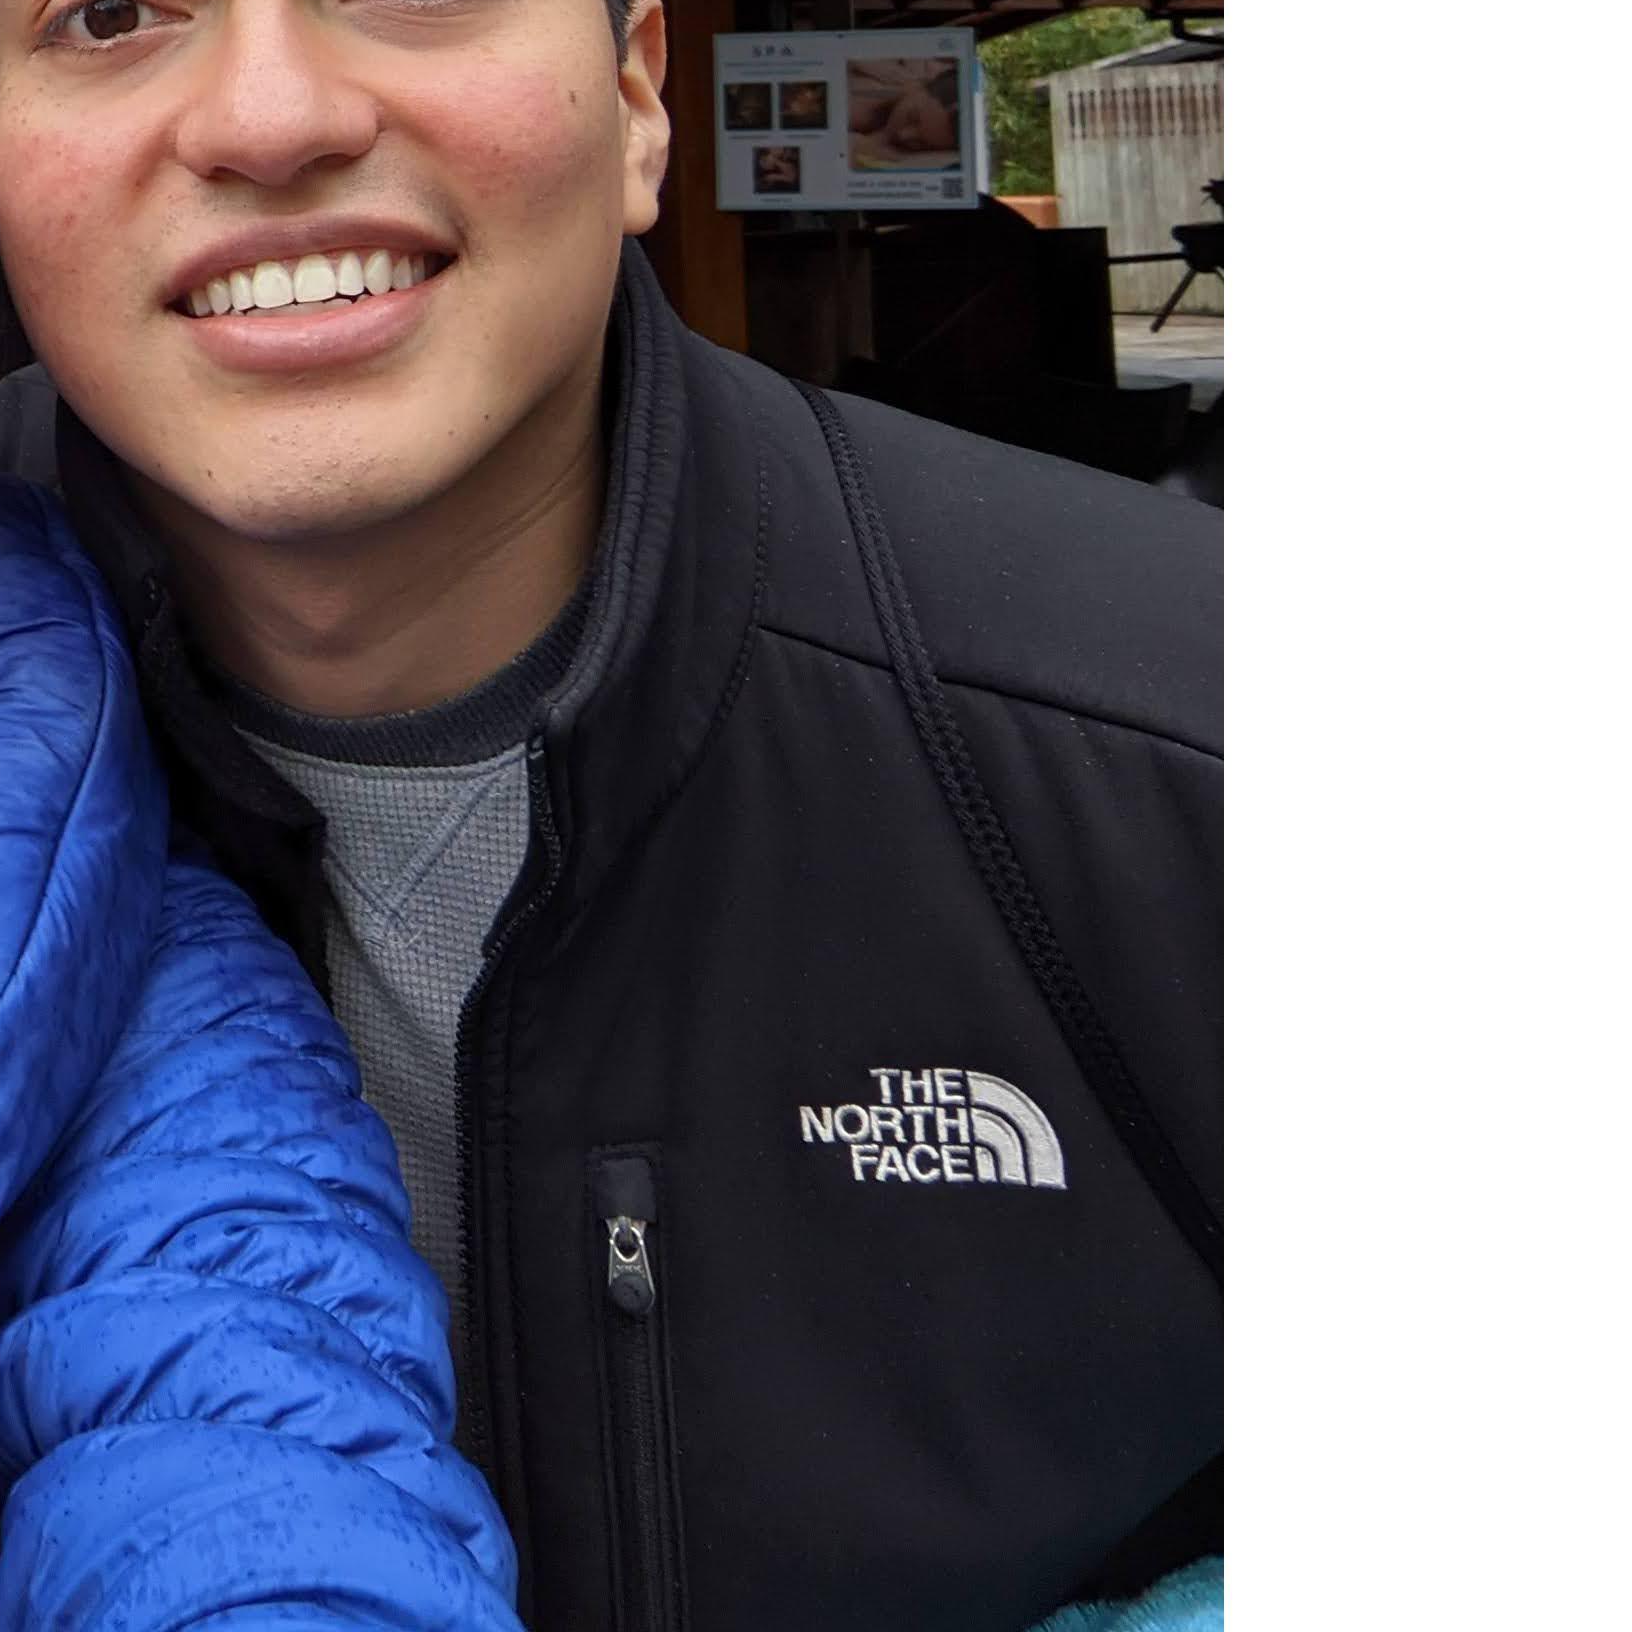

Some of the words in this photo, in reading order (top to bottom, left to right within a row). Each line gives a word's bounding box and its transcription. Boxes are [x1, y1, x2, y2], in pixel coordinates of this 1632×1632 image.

[870, 1068, 966, 1105] THE
[799, 1104, 970, 1144] NORTH
[850, 1143, 973, 1183] FACE
